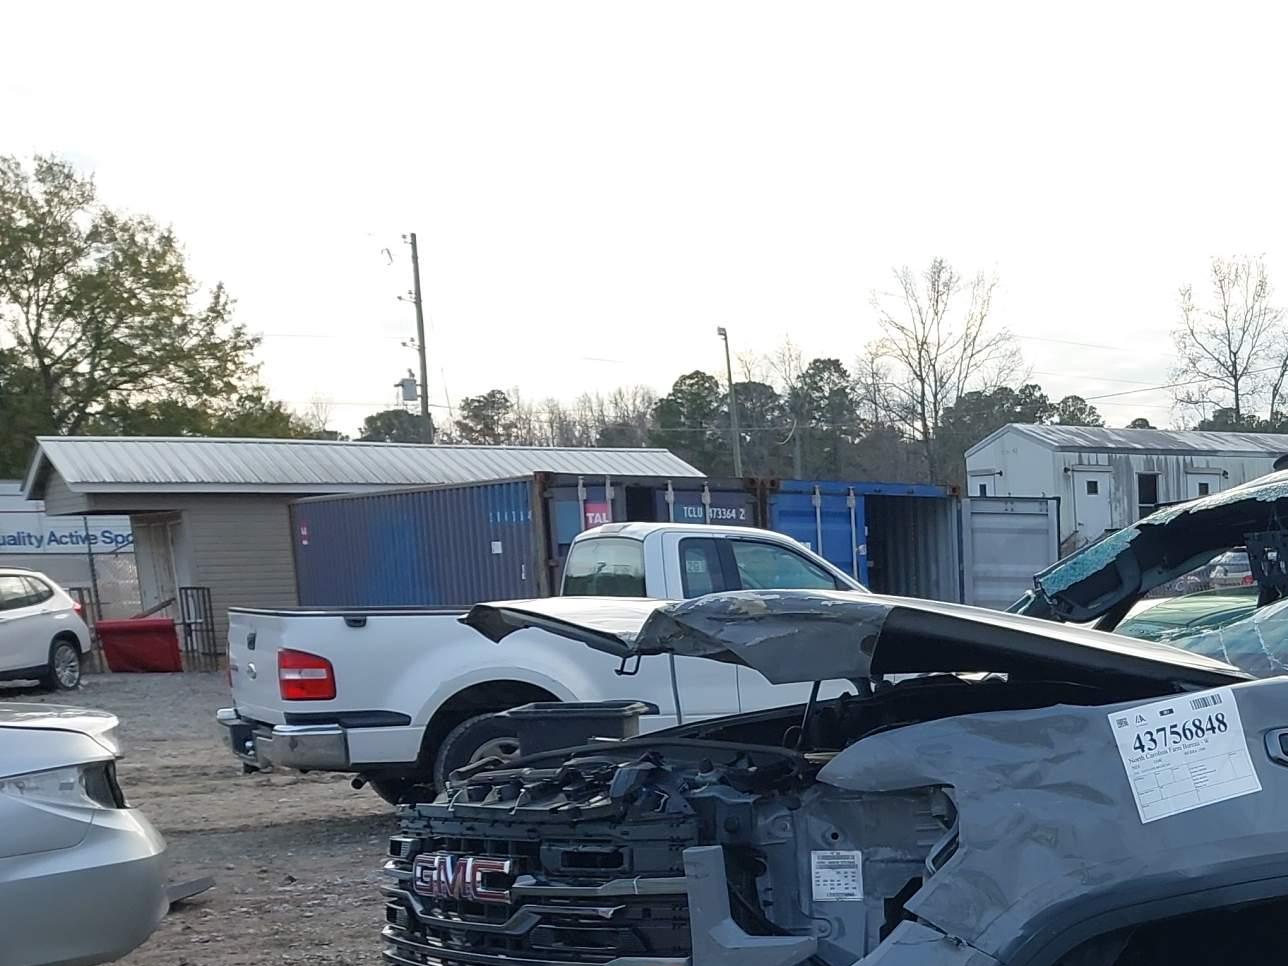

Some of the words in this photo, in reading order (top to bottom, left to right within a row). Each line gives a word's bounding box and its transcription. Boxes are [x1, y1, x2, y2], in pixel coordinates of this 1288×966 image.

[587, 512, 610, 524] TAL
[739, 508, 747, 521] 2
[48, 530, 98, 546] Active
[1132, 712, 1229, 753] 43756848
[413, 855, 511, 904] GMC
